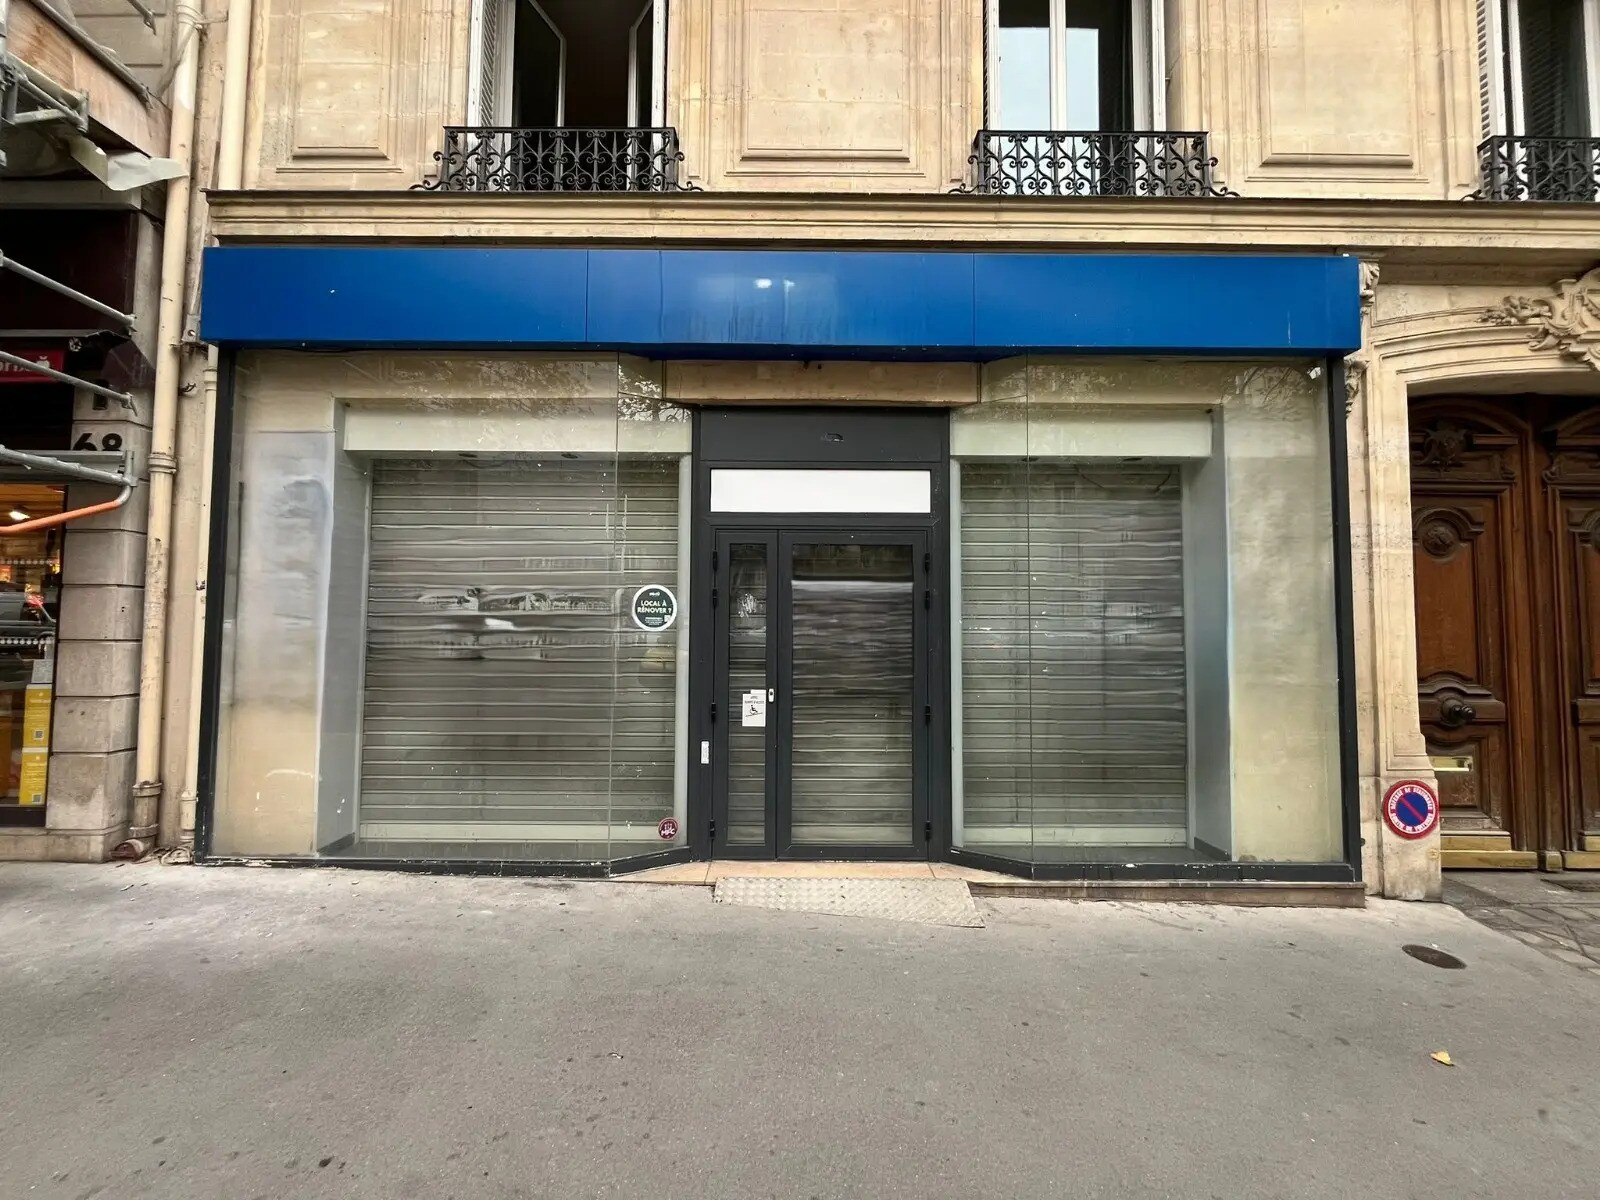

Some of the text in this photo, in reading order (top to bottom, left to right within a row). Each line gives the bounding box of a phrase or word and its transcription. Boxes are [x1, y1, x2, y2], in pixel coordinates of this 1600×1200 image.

[73, 433, 122, 451] 68
[662, 599, 667, 607] À
[637, 605, 667, 613] RÉNOVER
